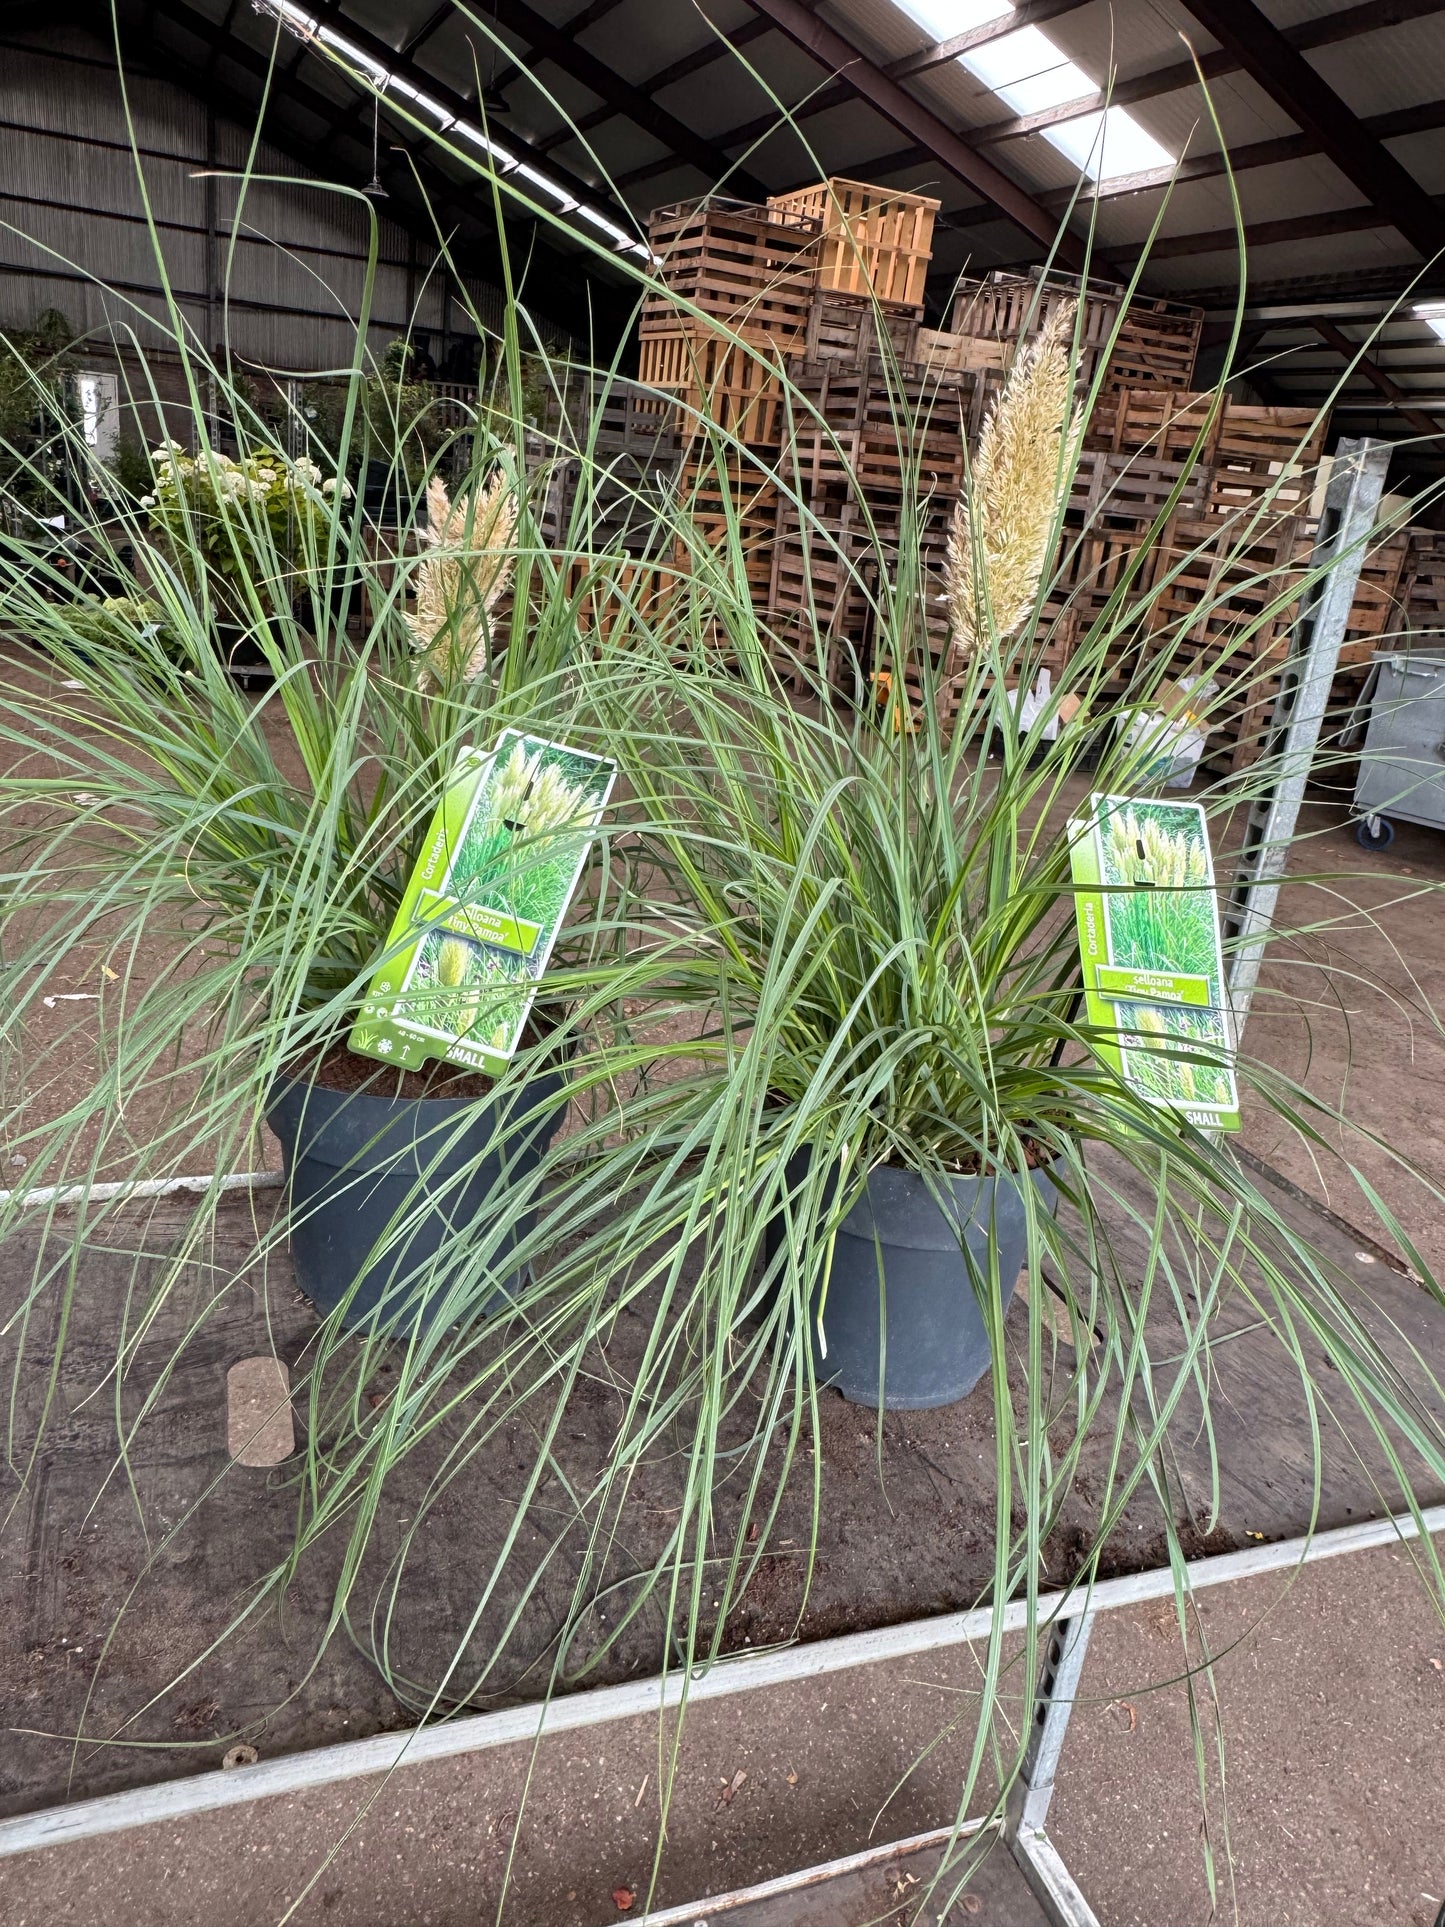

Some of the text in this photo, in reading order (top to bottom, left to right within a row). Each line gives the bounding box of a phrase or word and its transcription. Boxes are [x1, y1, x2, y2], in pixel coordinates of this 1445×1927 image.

[1084, 902, 1098, 956] Cortaderia
[1133, 974, 1174, 988] selloana
[445, 1044, 486, 1069] SMALL
[1185, 1110, 1224, 1127] SMALL
